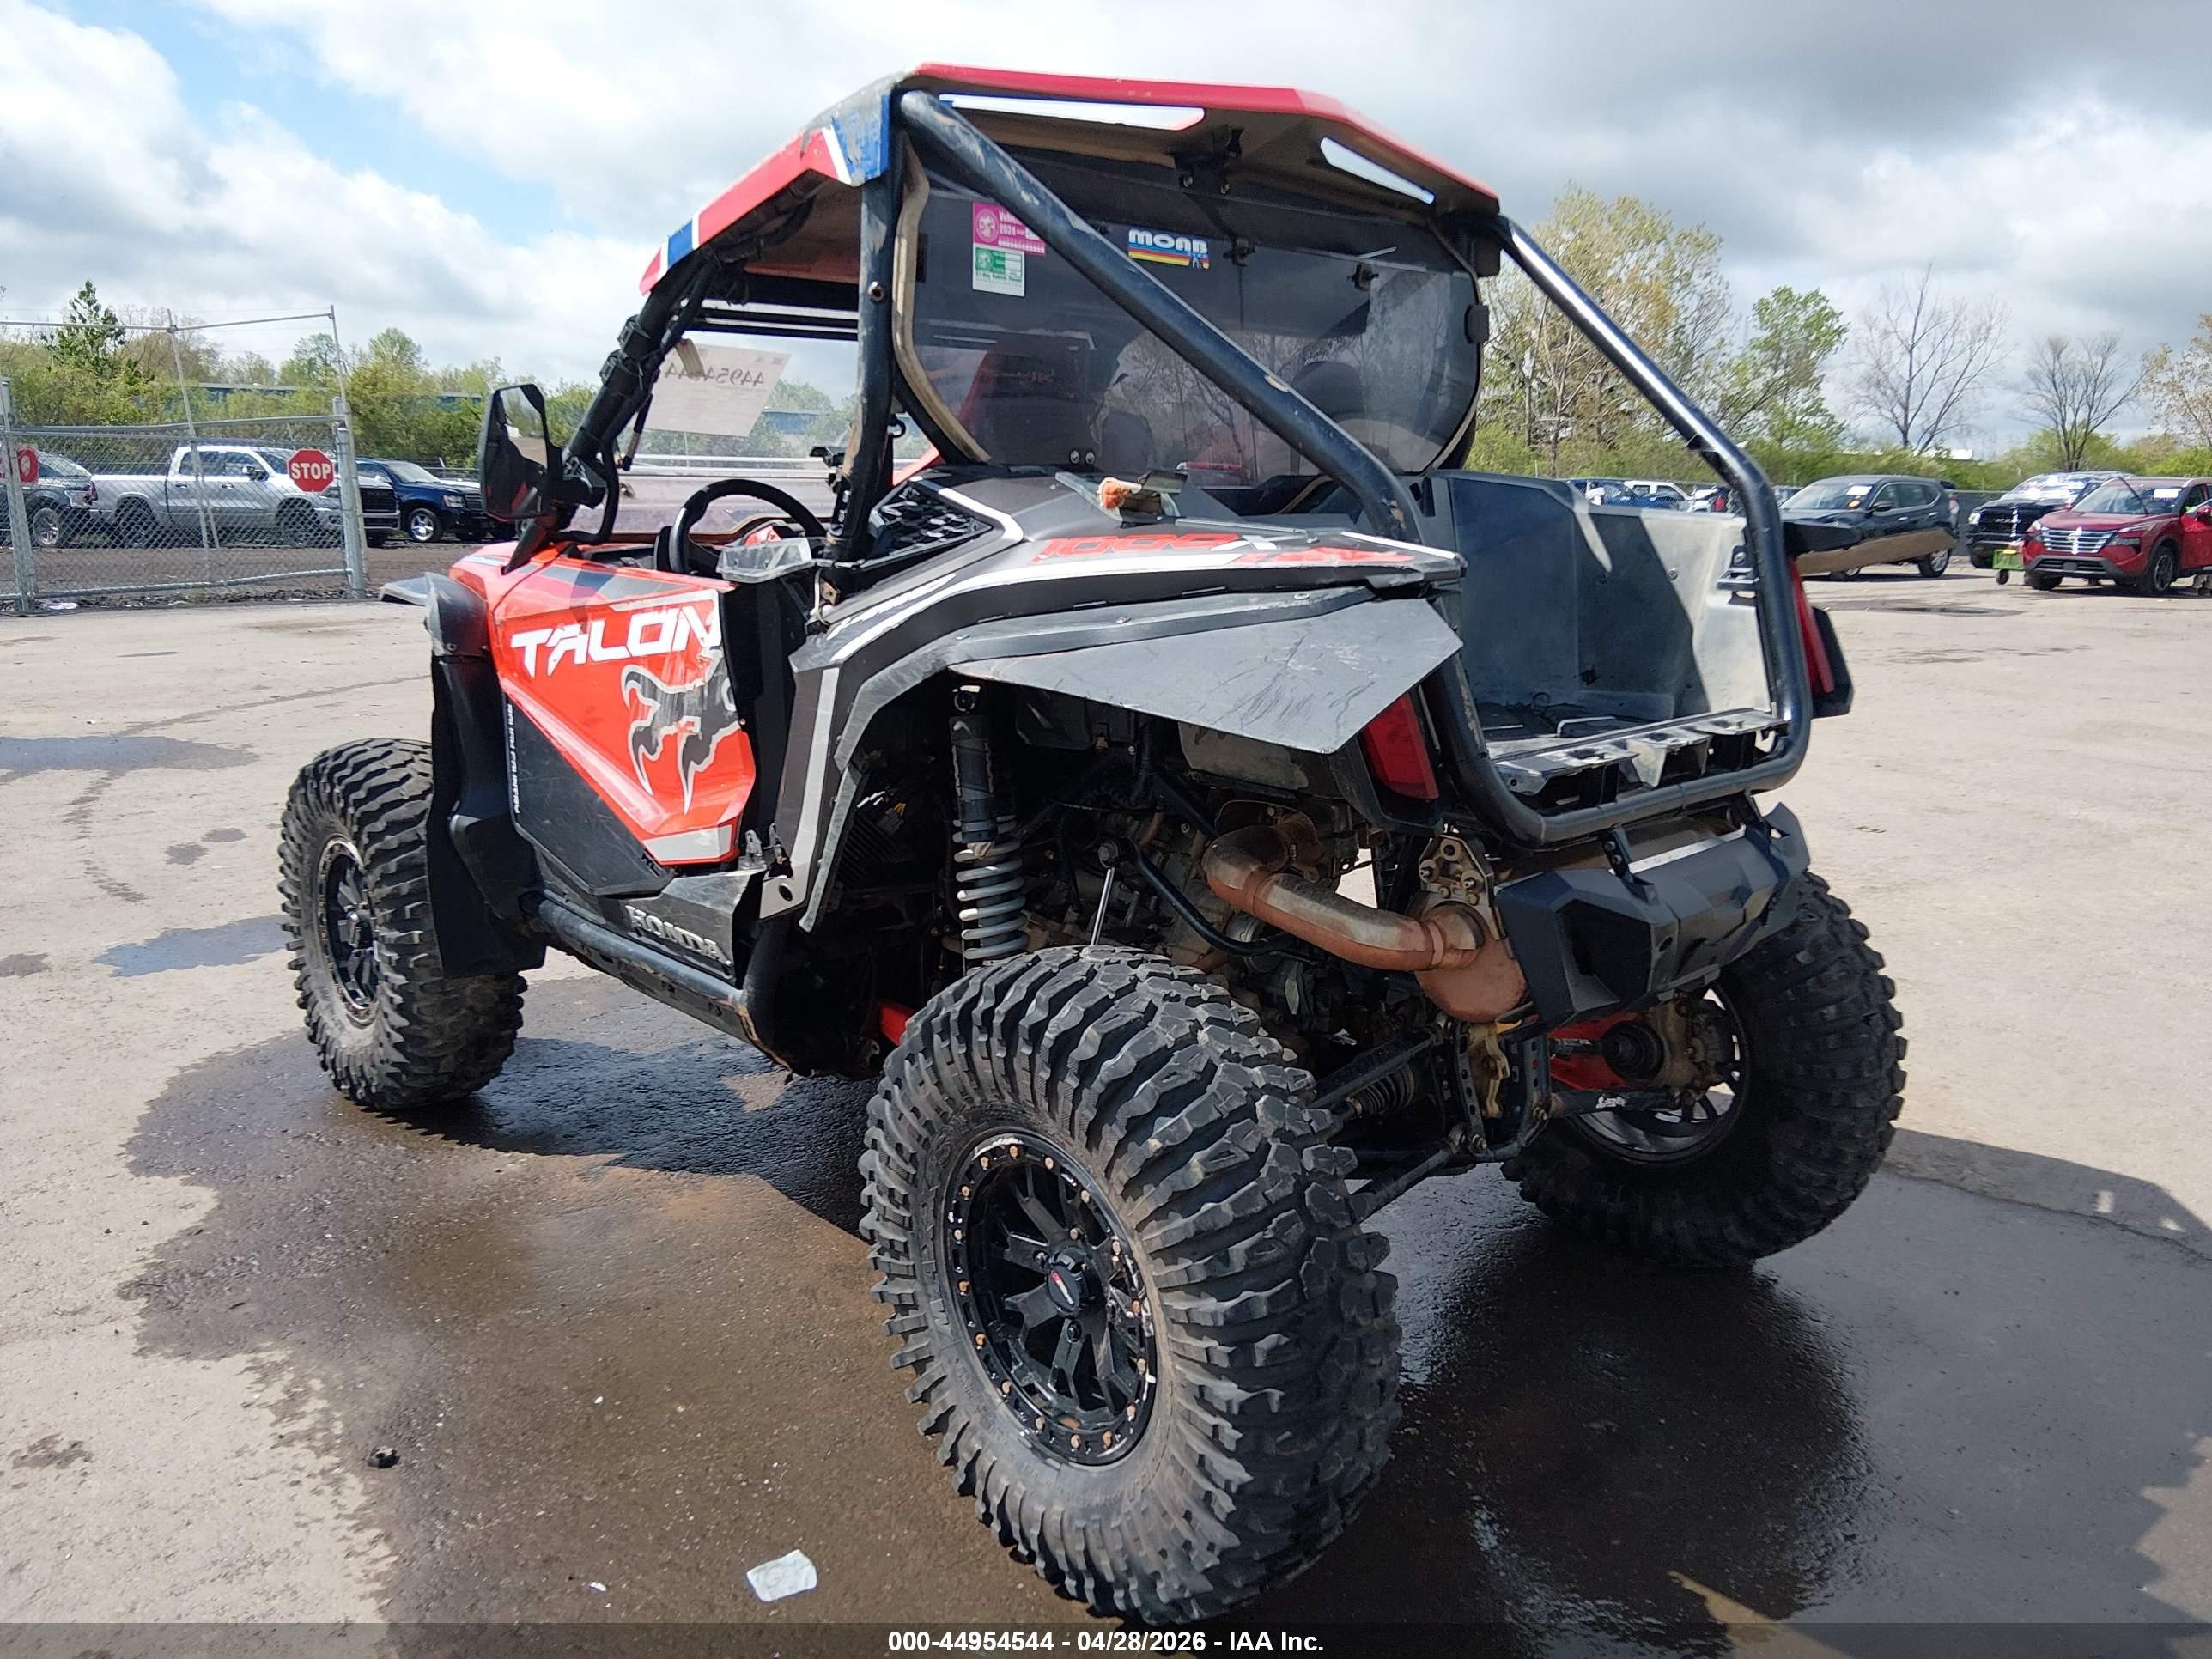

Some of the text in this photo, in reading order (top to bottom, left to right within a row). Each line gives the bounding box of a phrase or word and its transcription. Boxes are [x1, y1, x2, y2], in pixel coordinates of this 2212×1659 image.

[290, 462, 332, 480] STOP
[511, 605, 722, 678] TALON
[624, 904, 732, 966] HONDA
